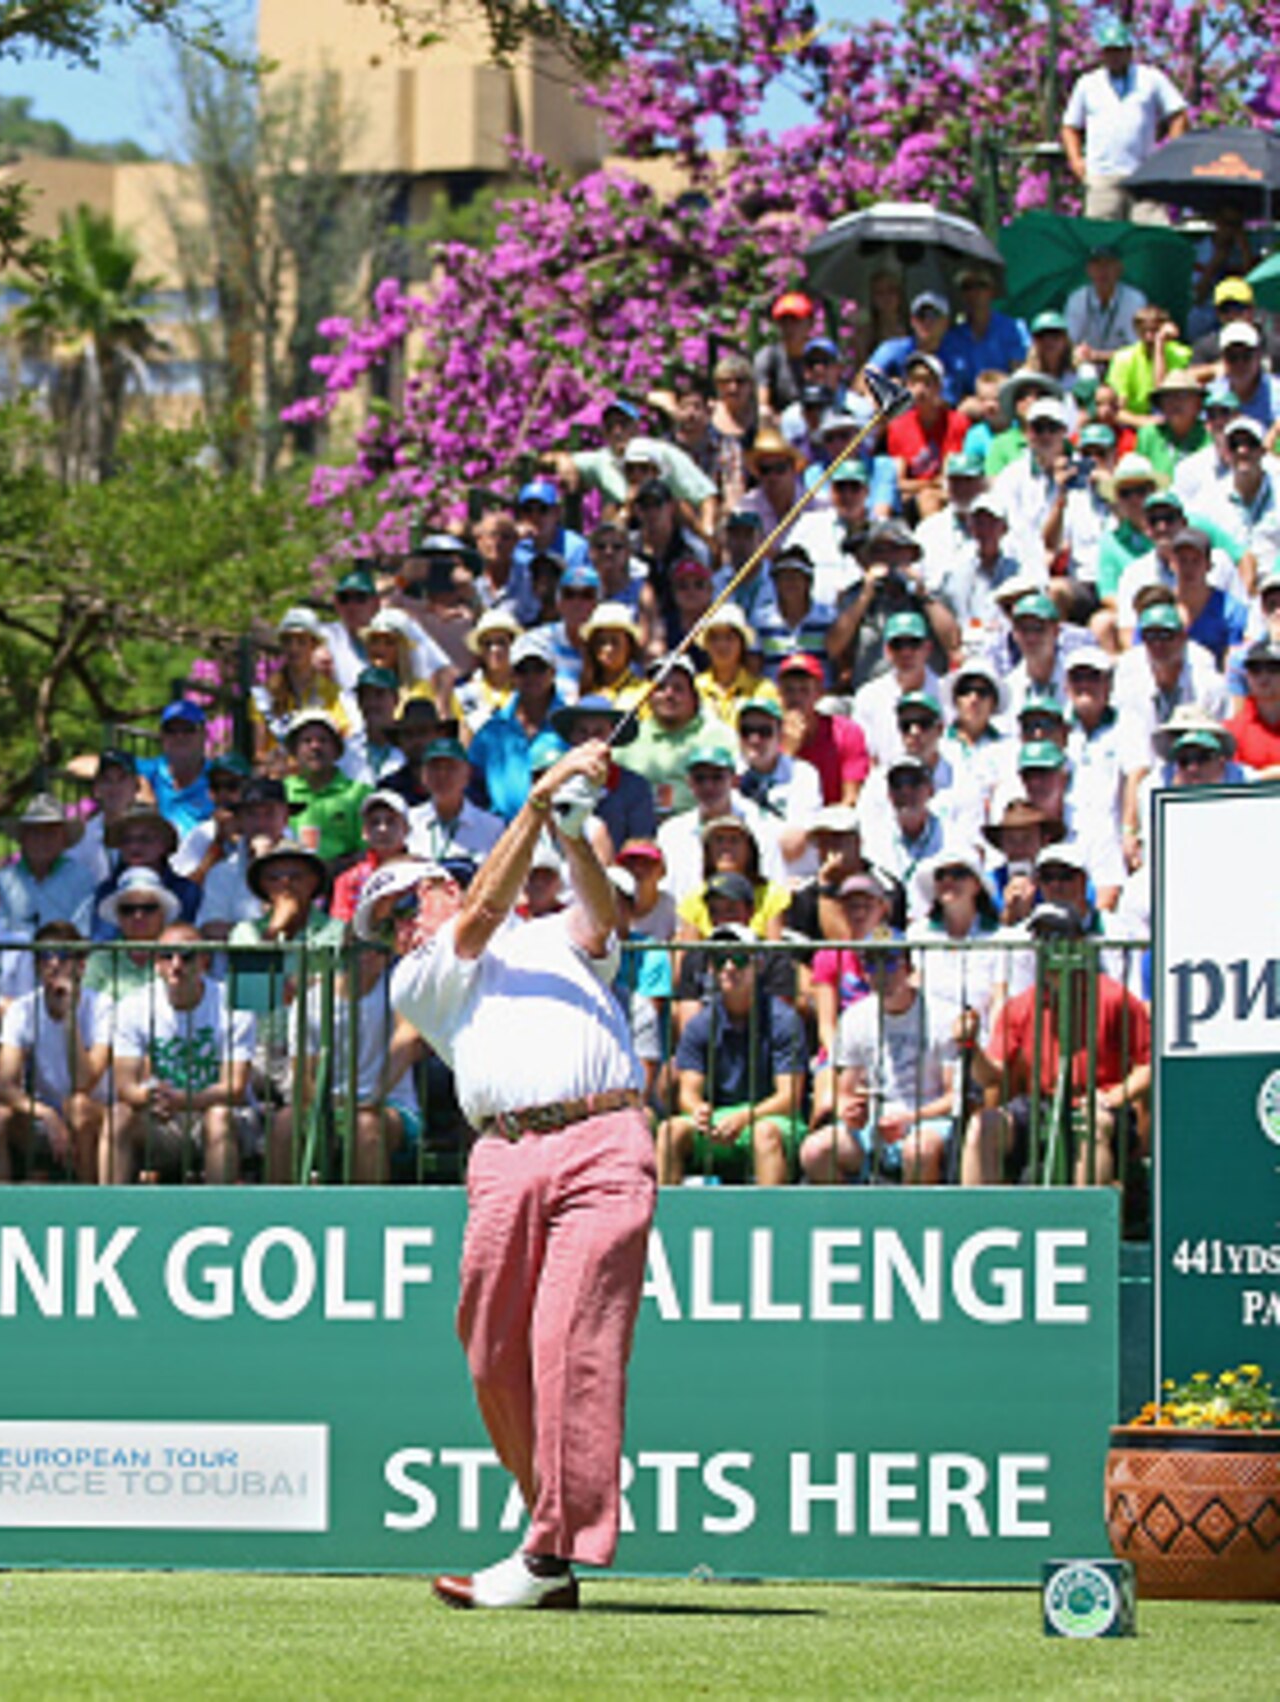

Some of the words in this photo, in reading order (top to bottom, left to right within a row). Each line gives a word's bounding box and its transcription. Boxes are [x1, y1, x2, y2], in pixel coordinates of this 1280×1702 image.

[165, 1225, 433, 1320] GOLF
[643, 1226, 1089, 1324] ALLENGE
[118, 1470, 174, 1496] TO
[181, 1470, 308, 1497] DUBAI
[163, 1447, 240, 1468] TOUR
[384, 1447, 756, 1534] STTS
[790, 1452, 1051, 1537] HERE
